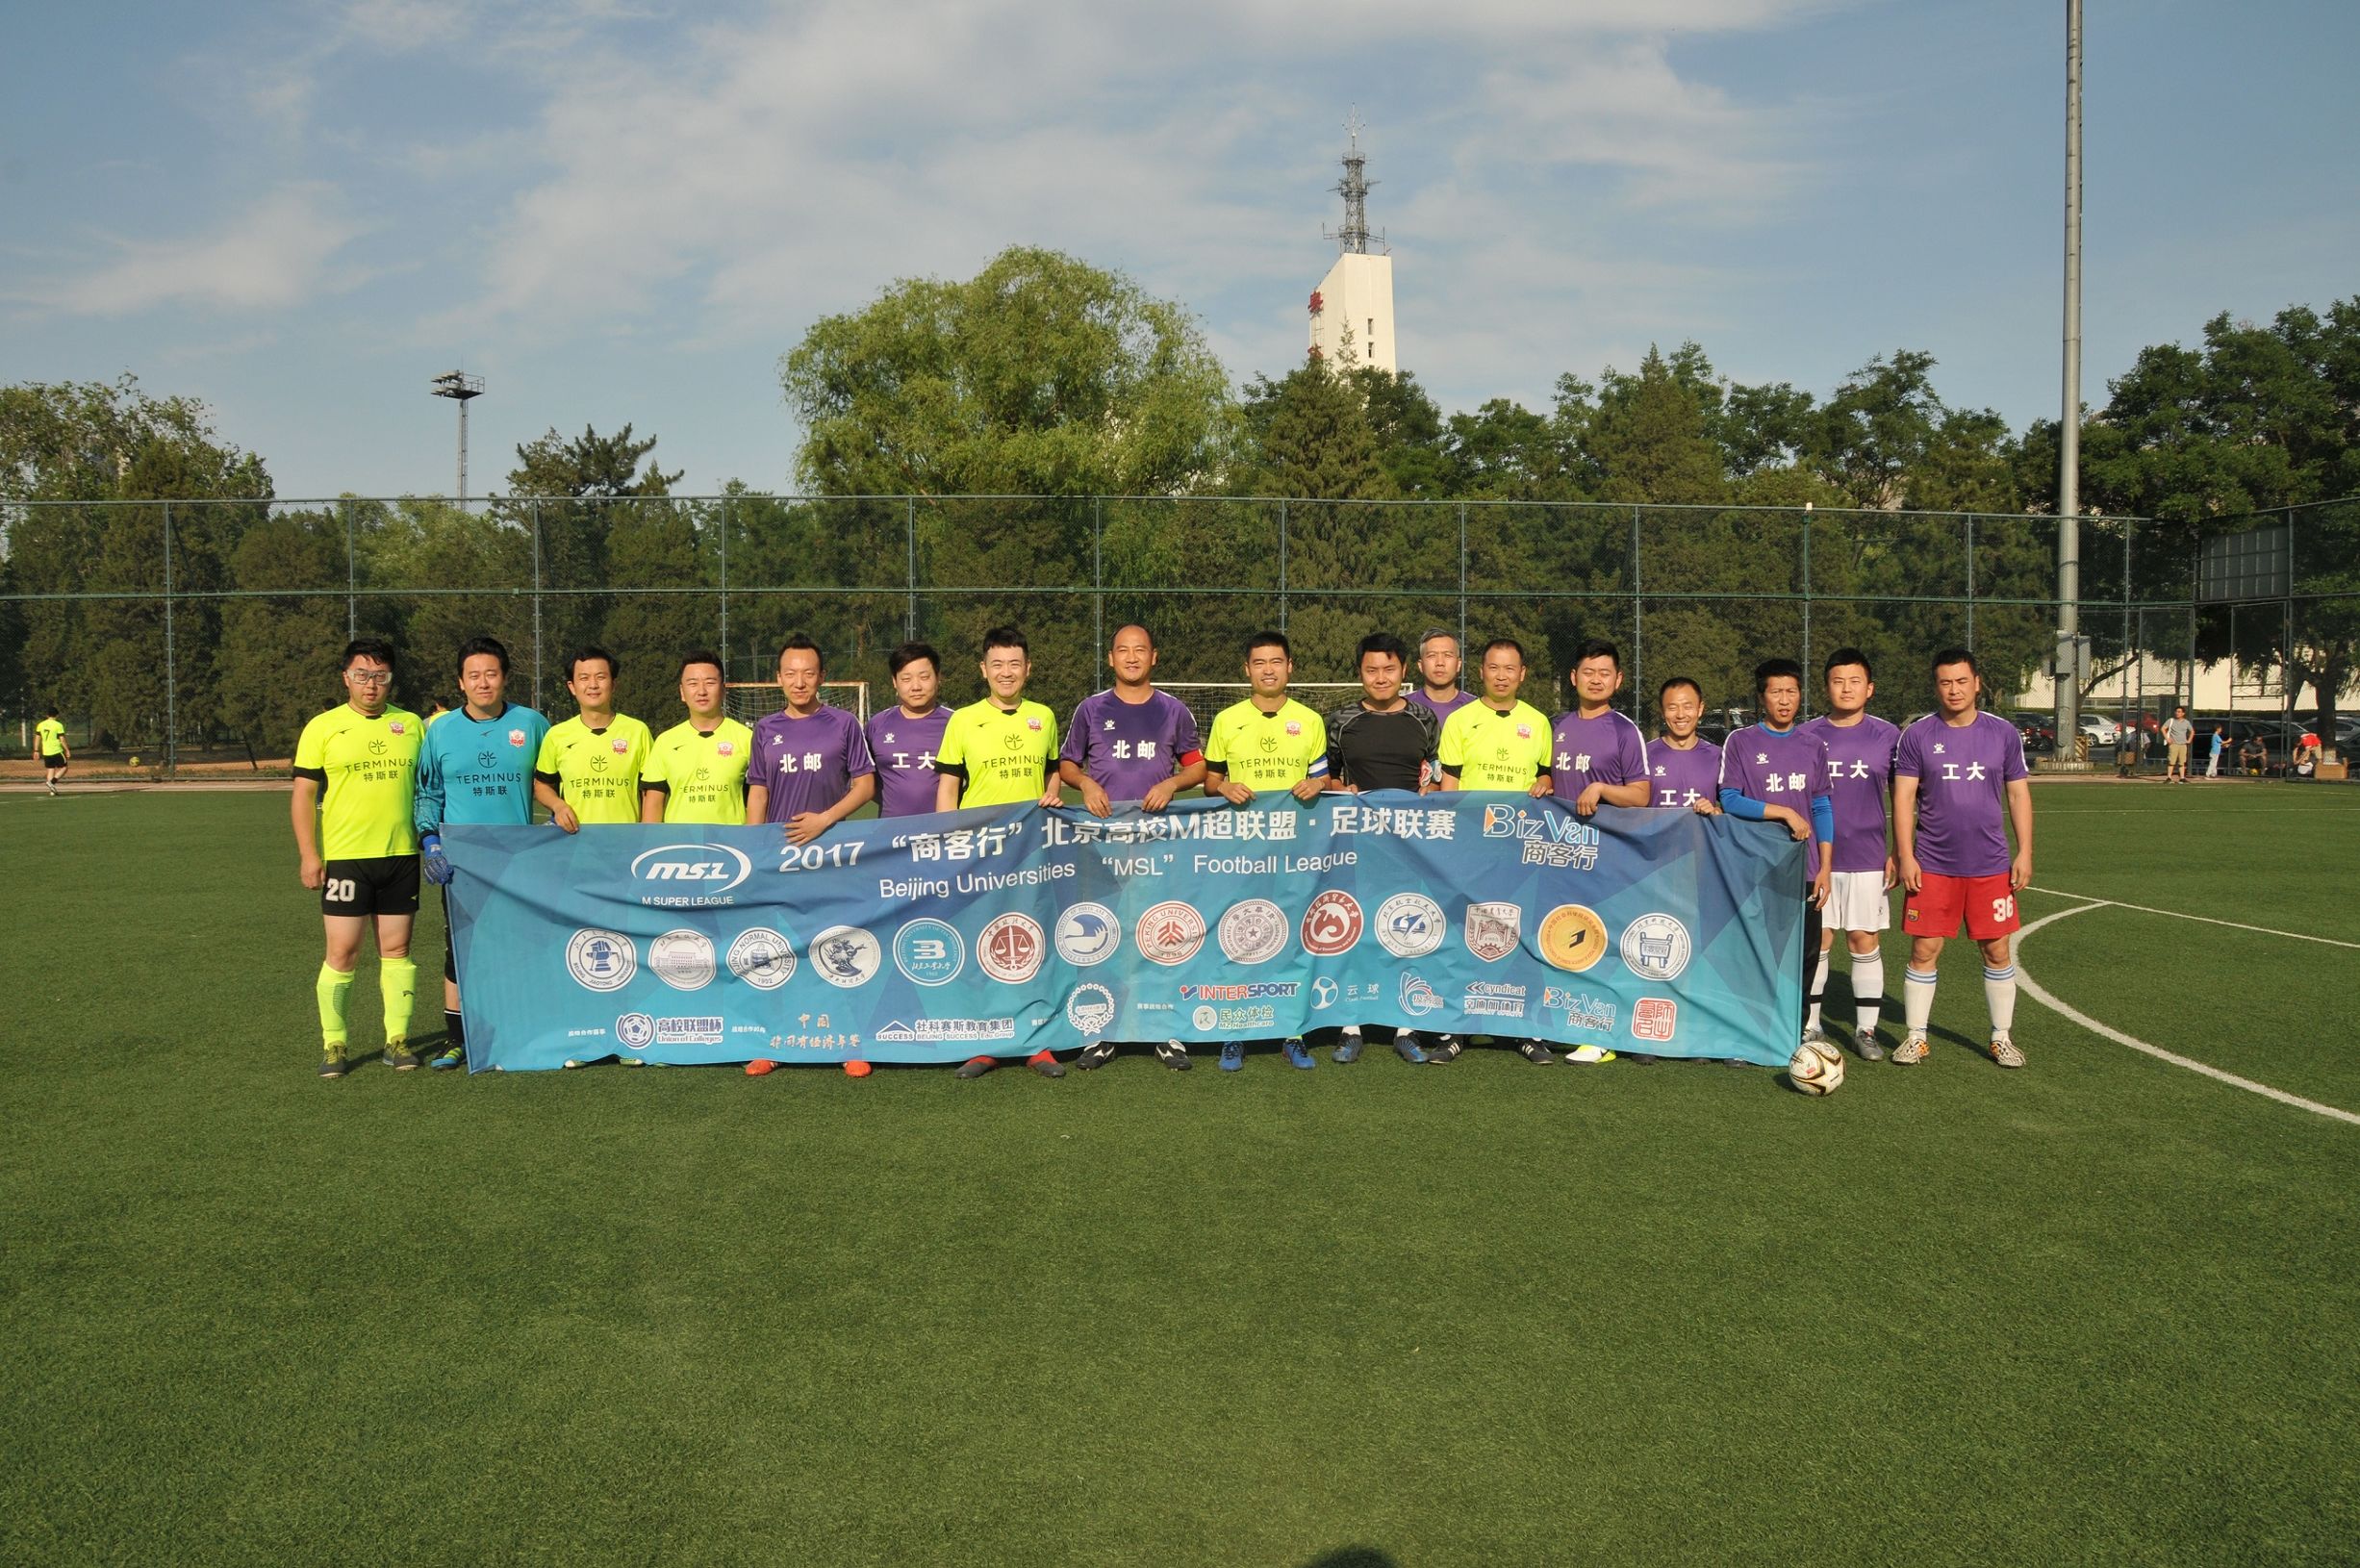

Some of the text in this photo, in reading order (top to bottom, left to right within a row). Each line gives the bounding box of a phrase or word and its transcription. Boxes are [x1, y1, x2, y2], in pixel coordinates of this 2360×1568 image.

[1112, 740, 1156, 761] 北邮
[344, 758, 414, 773] TERMINUS
[779, 752, 822, 773] 北邮
[892, 751, 936, 771] 工大
[982, 755, 1045, 769] TERMINUS
[1239, 757, 1301, 770] TERMINUS
[1556, 752, 1591, 773] 北邮
[363, 770, 398, 782] 特斯联
[999, 768, 1032, 779] 特斯联
[1254, 769, 1286, 779] 特斯联
[1477, 763, 1528, 775] TERMINUS
[1828, 760, 1869, 779] 工大
[1941, 761, 1986, 781] 工大
[456, 772, 521, 784] TERMINUS
[570, 777, 630, 789] TERMINUS
[1486, 773, 1514, 784] 特斯联
[1765, 772, 1806, 793] 北邮
[472, 785, 508, 797] 特斯联
[582, 789, 616, 799] 特斯联
[688, 794, 716, 803] 特斯联
[1660, 788, 1701, 807] 工大
[778, 842, 865, 873] 2017
[1522, 840, 1598, 871] 商客行
[879, 877, 950, 901] Beijing
[956, 861, 1076, 894] Universities
[1194, 853, 1278, 874] Football
[1285, 849, 1358, 873] League
[326, 878, 356, 902] 20
[642, 896, 734, 907] M SUPER LEAGUE
[1992, 894, 2014, 923] 36
[1145, 915, 1159, 948] PEKING
[739, 933, 771, 949] NORMAL
[1200, 982, 1298, 1000] INTERSPORT
[1347, 983, 1380, 996] 云球
[658, 1018, 723, 1033] 高校联盟杯
[916, 1019, 1013, 1032] 社科赛斯教育集团
[1567, 1010, 1615, 1032] 商客行
